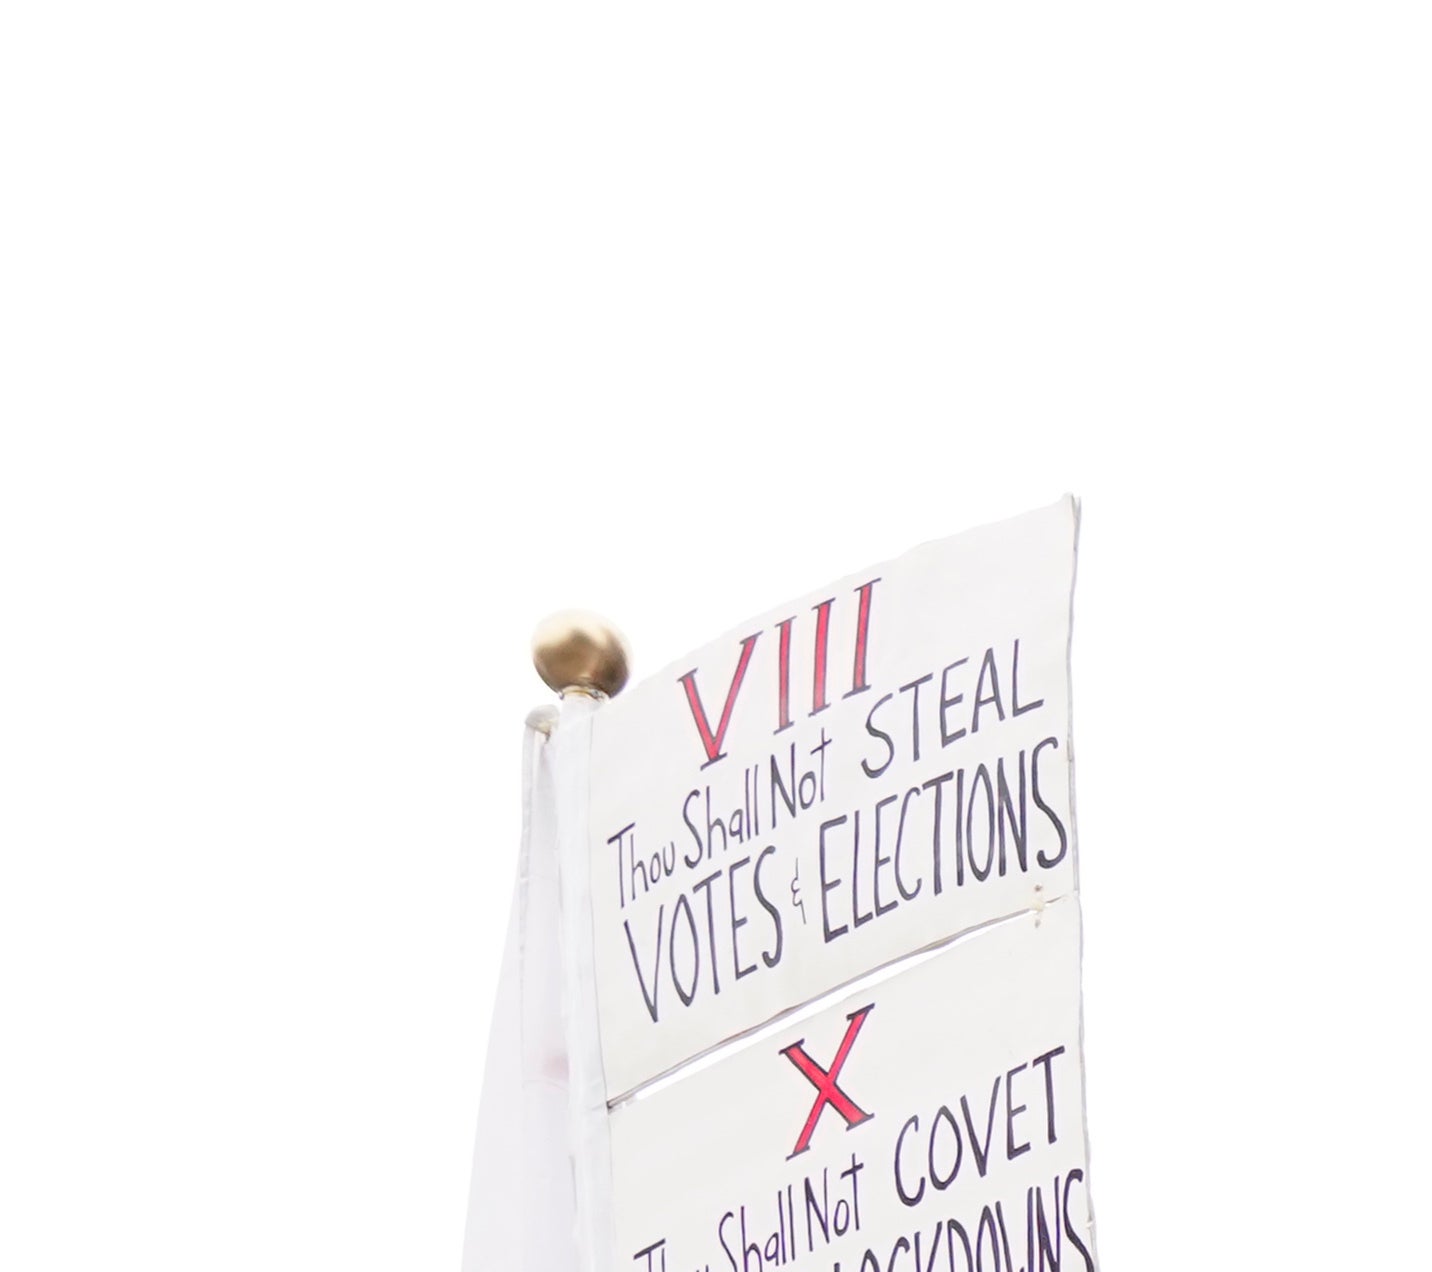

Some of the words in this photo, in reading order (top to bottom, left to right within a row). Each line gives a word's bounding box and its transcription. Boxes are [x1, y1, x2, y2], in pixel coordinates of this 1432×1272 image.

[607, 821, 676, 910] Thou
[683, 764, 763, 869] Shall
[771, 737, 831, 841] Not
[861, 639, 1044, 780] STEAL
[680, 577, 881, 771] VIII
[622, 841, 781, 1023] VOTES
[817, 734, 1067, 944] ELECTIONS
[778, 1002, 874, 1160] X
[805, 1154, 864, 1246] Not
[894, 1045, 1065, 1209] COVET
